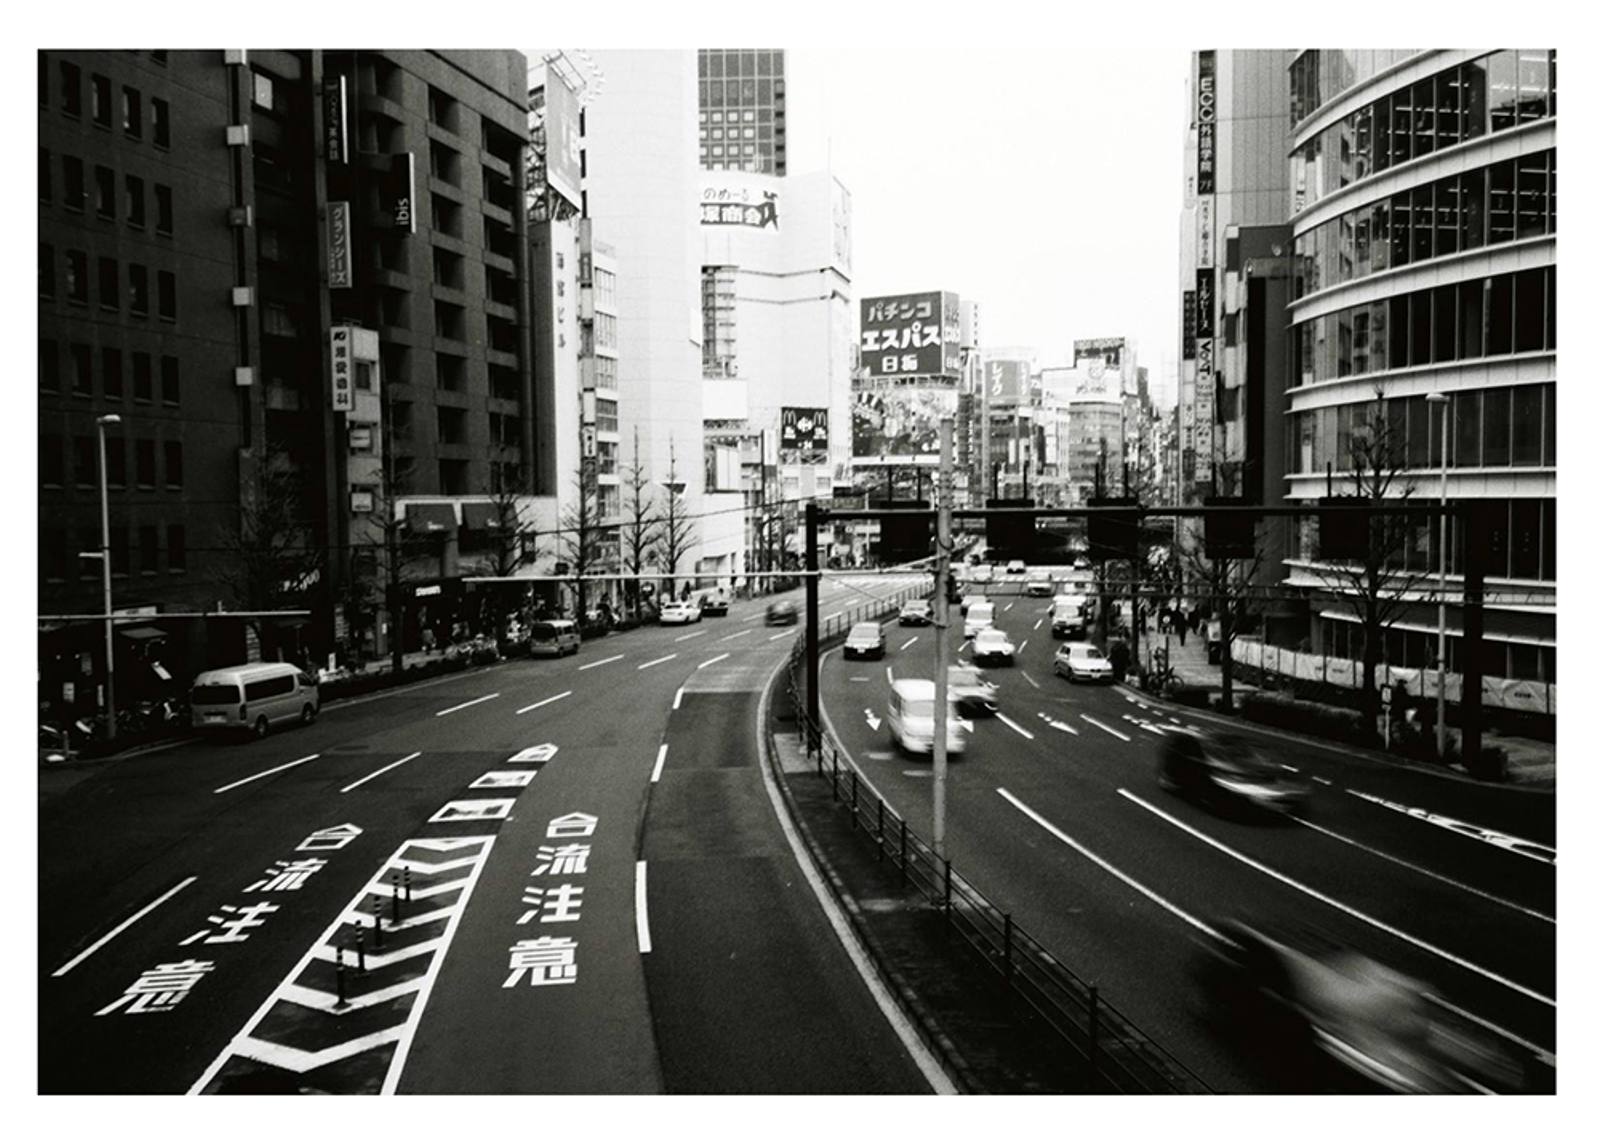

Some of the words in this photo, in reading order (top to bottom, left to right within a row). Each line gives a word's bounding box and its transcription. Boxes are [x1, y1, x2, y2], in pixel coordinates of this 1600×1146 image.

[1200, 77, 1213, 121] ECC
[395, 198, 409, 225] ibis
[868, 301, 932, 323] パチンコ
[862, 321, 941, 352] エスパス
[991, 362, 1003, 396] レイク
[501, 811, 599, 989] 合流注意
[94, 822, 364, 1016] 合流注意
